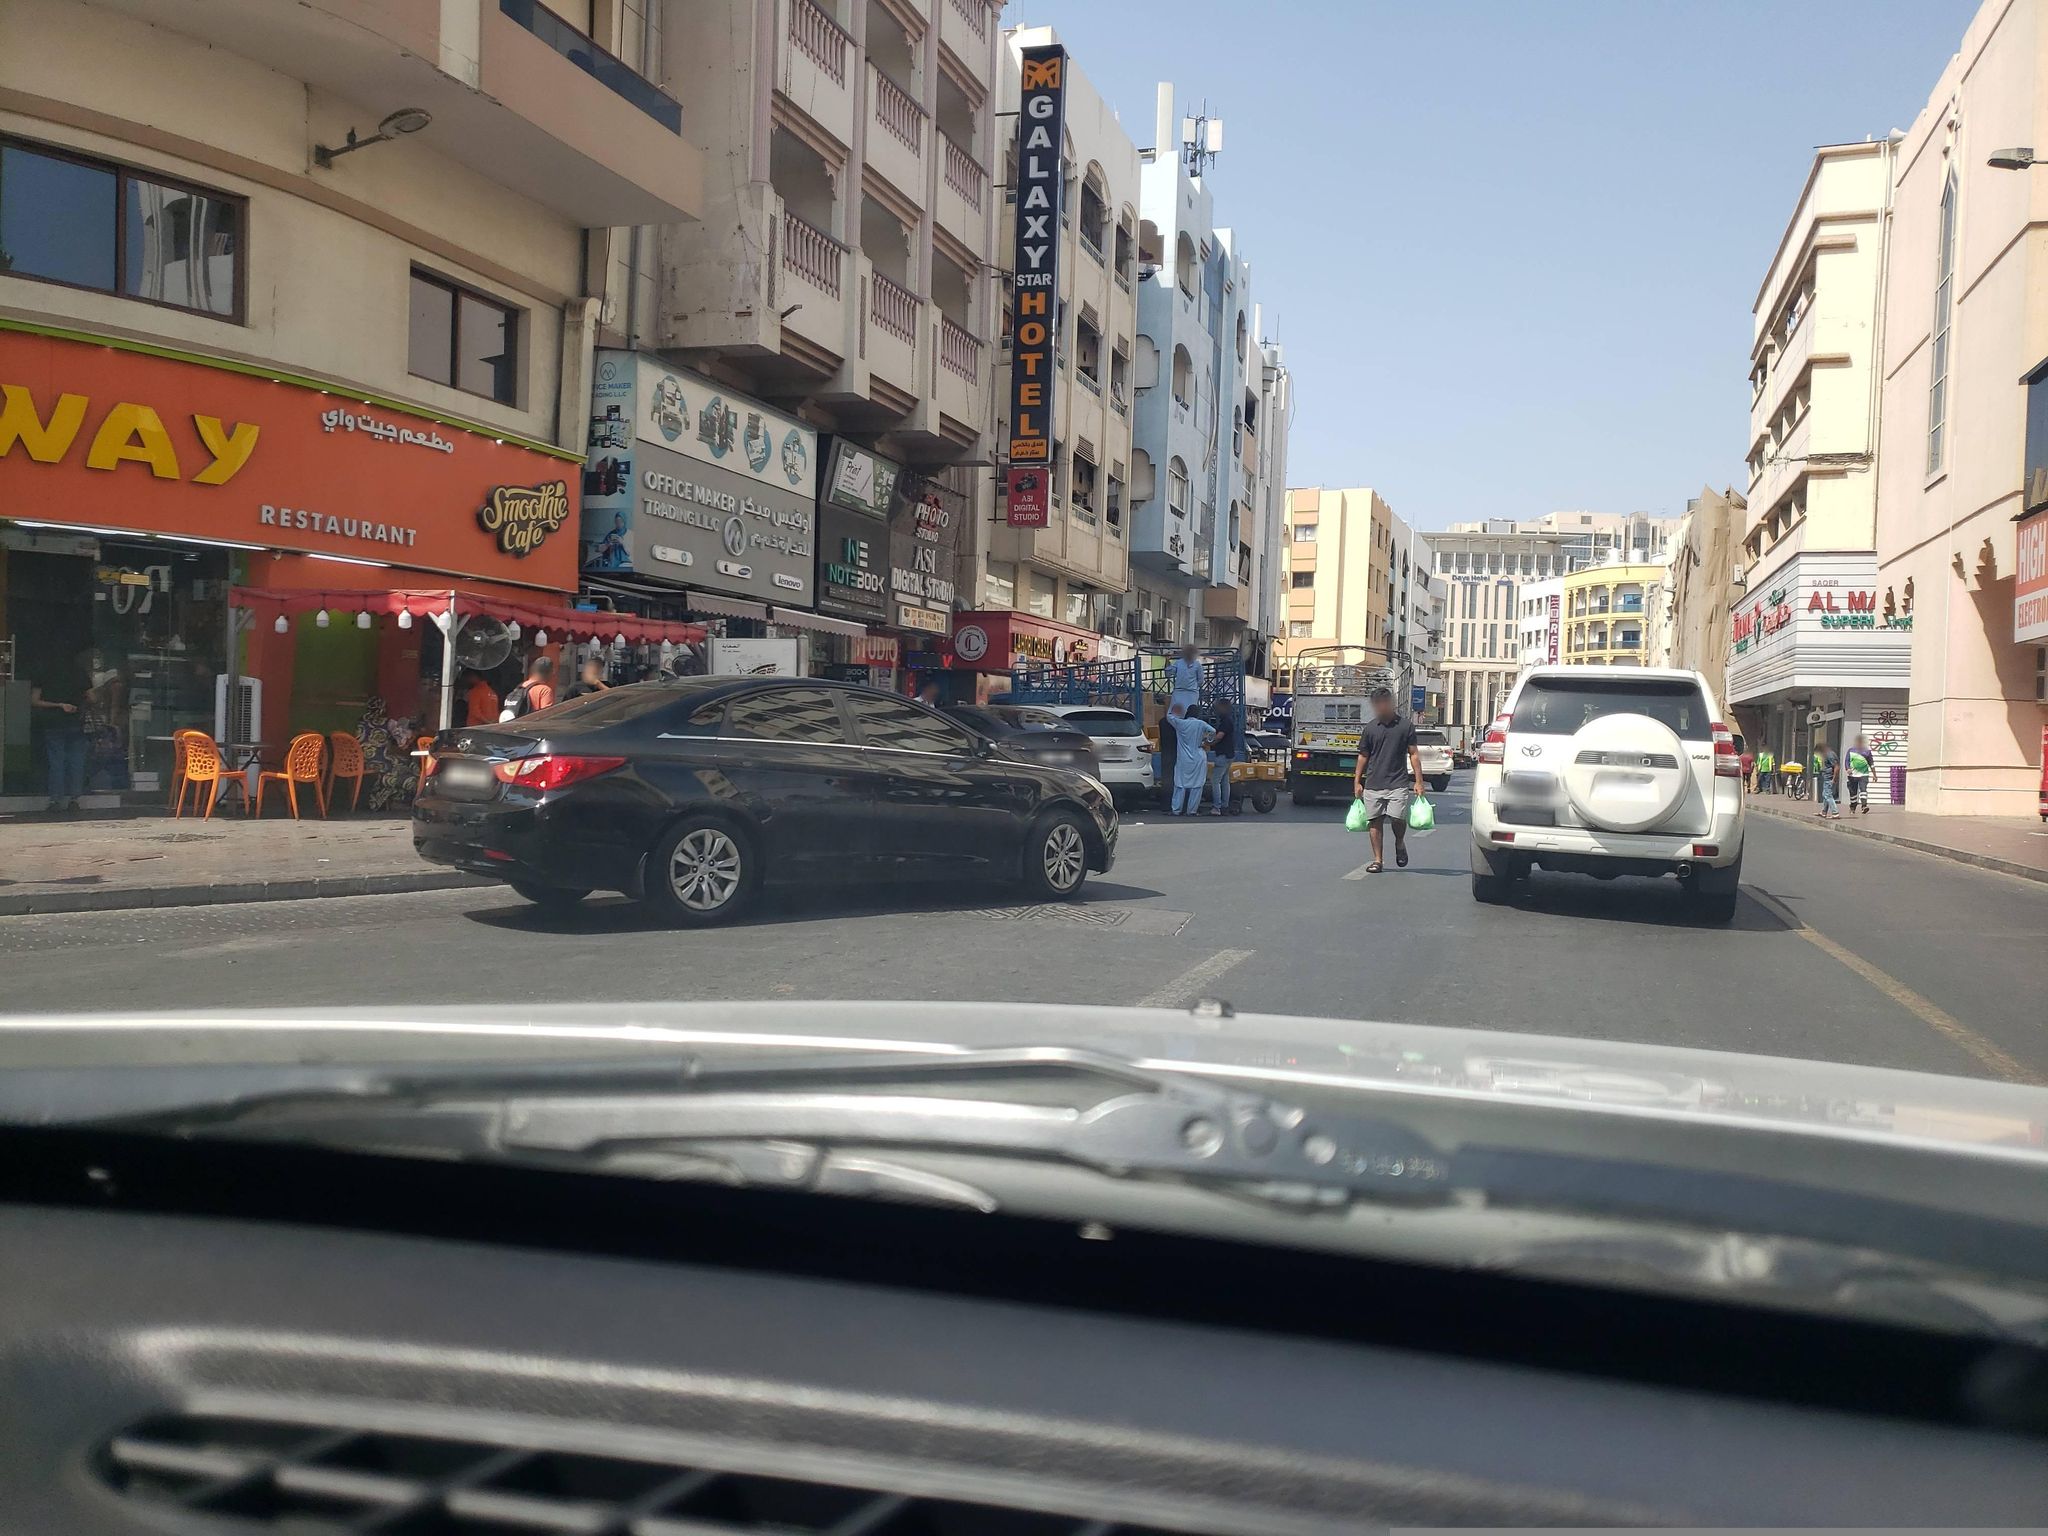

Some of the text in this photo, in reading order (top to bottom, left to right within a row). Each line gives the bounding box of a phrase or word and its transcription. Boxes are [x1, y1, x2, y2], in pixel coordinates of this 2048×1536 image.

[1024, 95, 1054, 268] GALAXY
[1017, 274, 1052, 286] STAR
[1019, 292, 1046, 436] HOTEL
[321, 408, 454, 453] مطعم جيت واي
[483, 480, 569, 530] Smoothie
[645, 470, 736, 513] OFFICE MAKER
[260, 504, 417, 546] RESTAURANT
[643, 498, 694, 526] TRADING
[915, 501, 949, 528] PHOTO
[915, 545, 936, 574] ASI
[2018, 520, 2047, 585] HIGH
[825, 562, 885, 594] NOTEBOOK
[891, 567, 926, 597] DIGITAL
[926, 578, 955, 603] STUDIO
[1452, 574, 1470, 582] Days
[1808, 591, 1840, 611] AL
